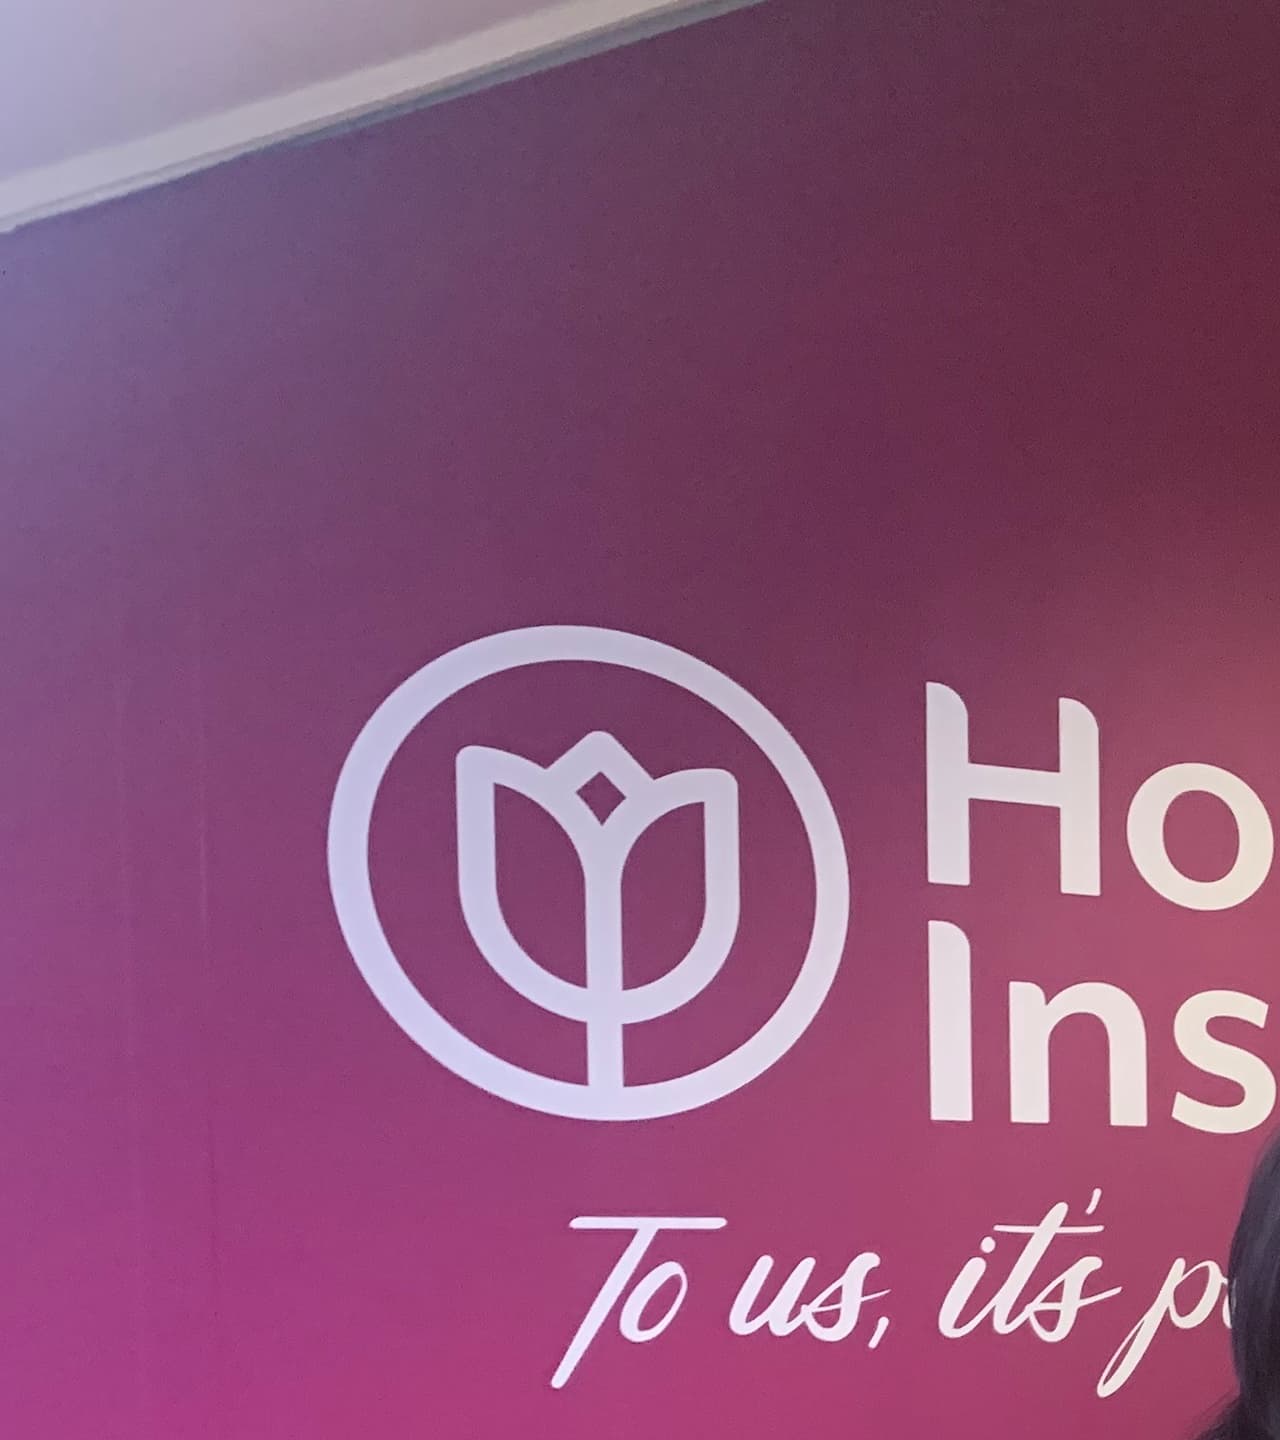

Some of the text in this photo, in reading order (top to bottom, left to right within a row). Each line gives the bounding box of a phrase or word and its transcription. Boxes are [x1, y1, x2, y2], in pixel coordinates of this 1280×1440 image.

[551, 1216, 726, 1389] To
[729, 1250, 890, 1348] us,
[938, 1188, 1122, 1343] it's
